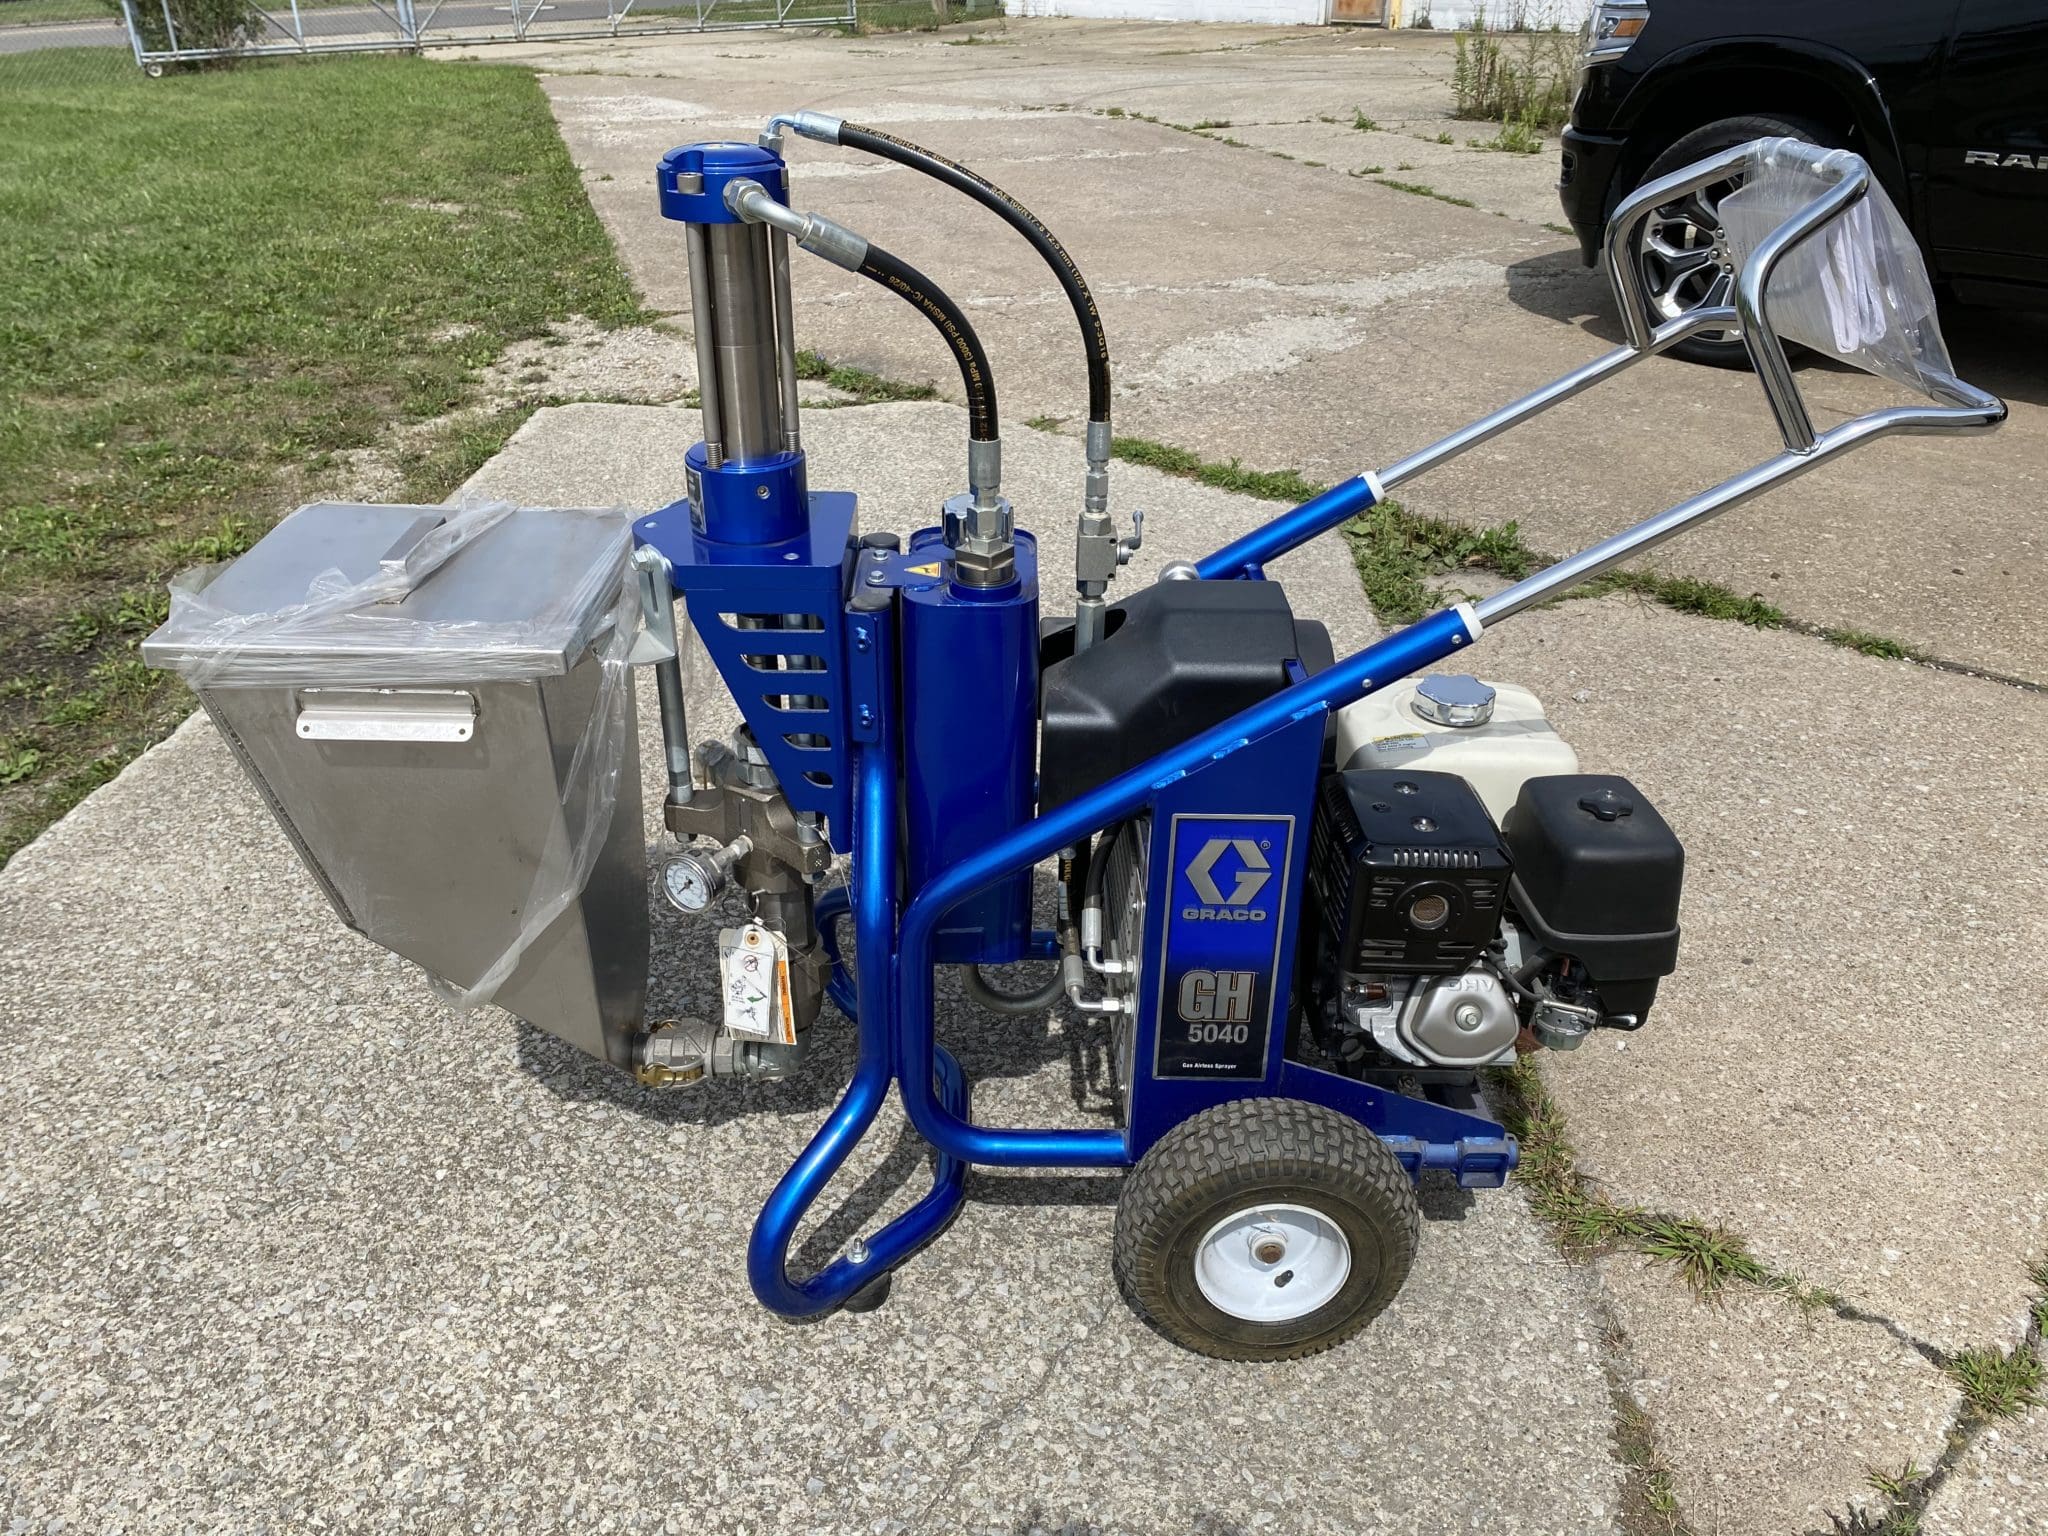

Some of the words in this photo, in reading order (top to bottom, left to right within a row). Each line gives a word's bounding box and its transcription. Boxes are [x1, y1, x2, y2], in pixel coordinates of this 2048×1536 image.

[923, 298, 947, 322] MSHA
[969, 362, 981, 382] MPa
[1182, 908, 1267, 922] GRACO
[1179, 970, 1256, 1022] GH
[1188, 1024, 1249, 1044] 5040
[1215, 1062, 1237, 1070] Sprayer
